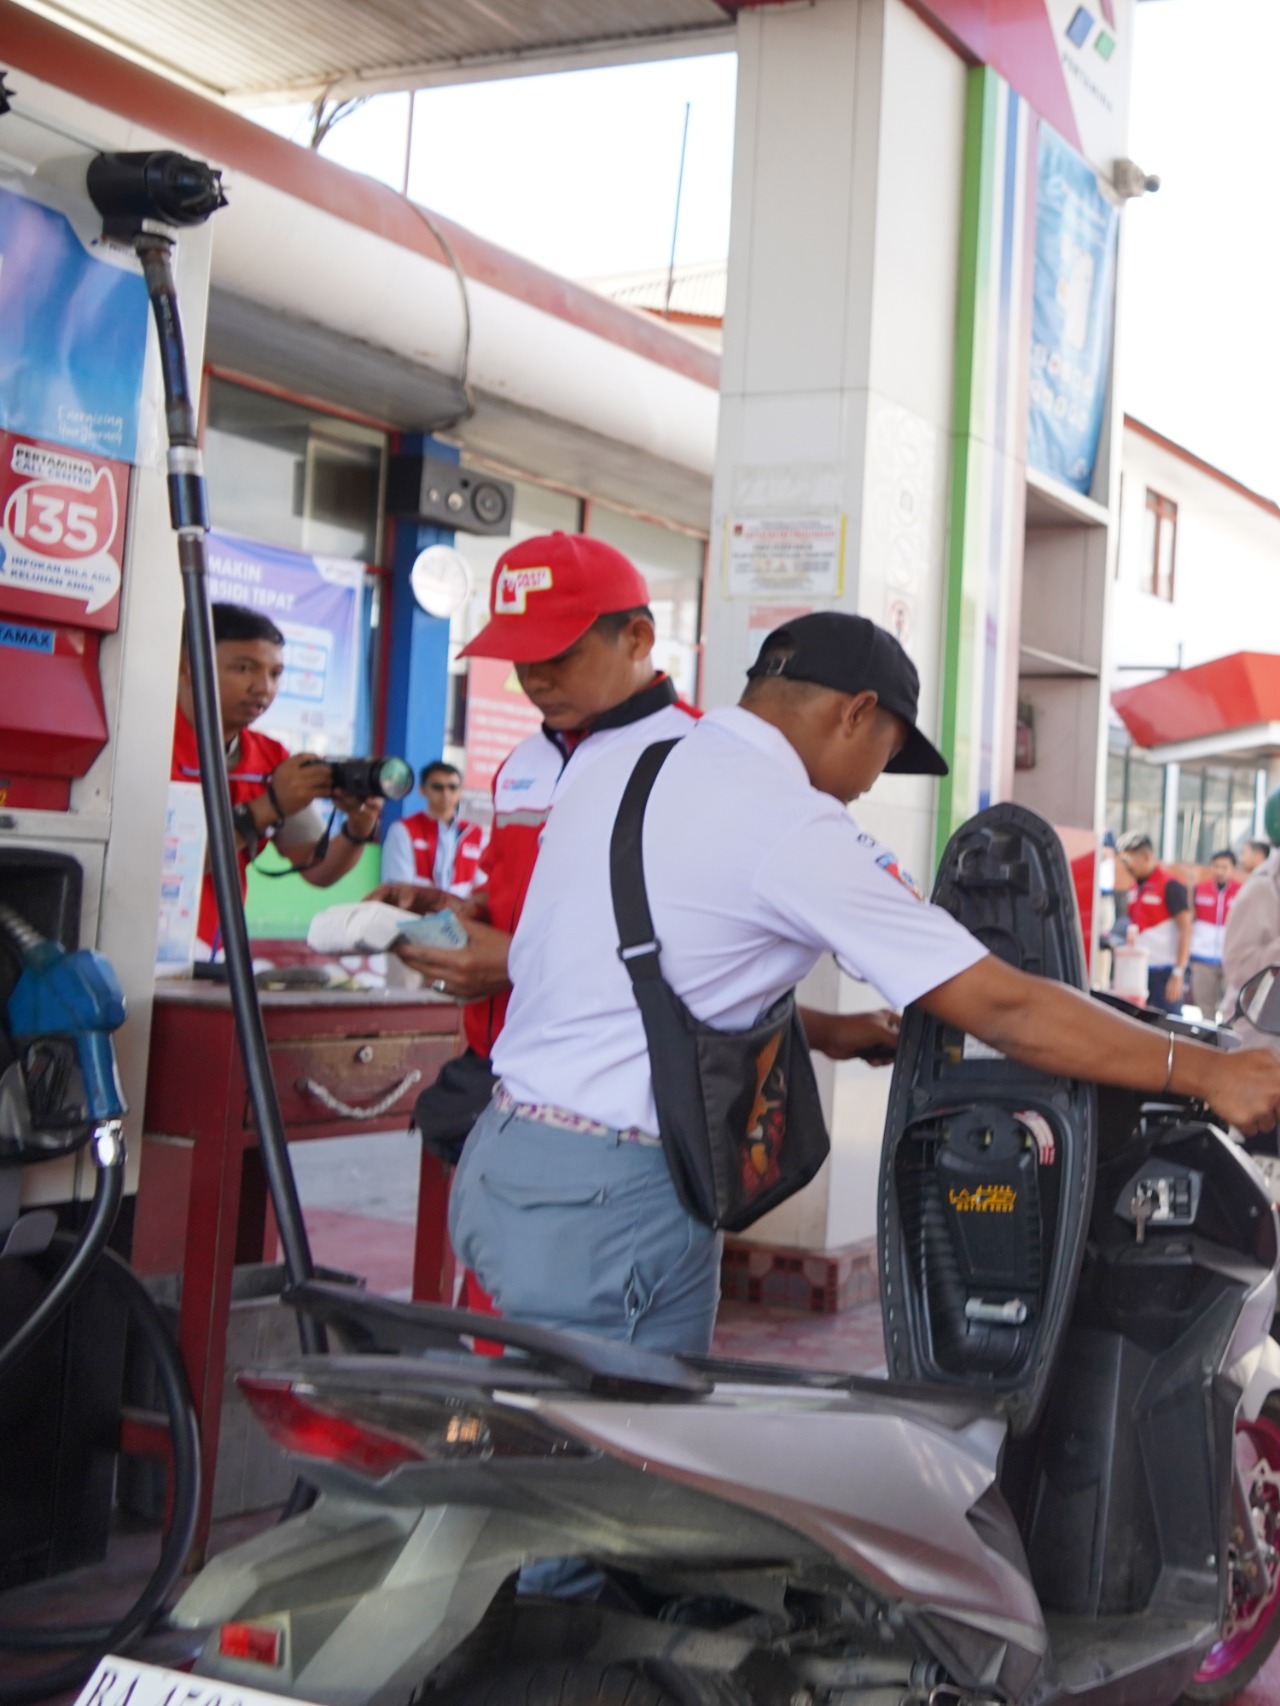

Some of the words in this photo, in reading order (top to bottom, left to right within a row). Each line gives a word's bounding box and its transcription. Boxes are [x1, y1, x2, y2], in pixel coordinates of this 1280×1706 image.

[16, 448, 92, 475] PERTAMINA
[13, 489, 98, 552] 135
[0, 626, 51, 648] AMAX
